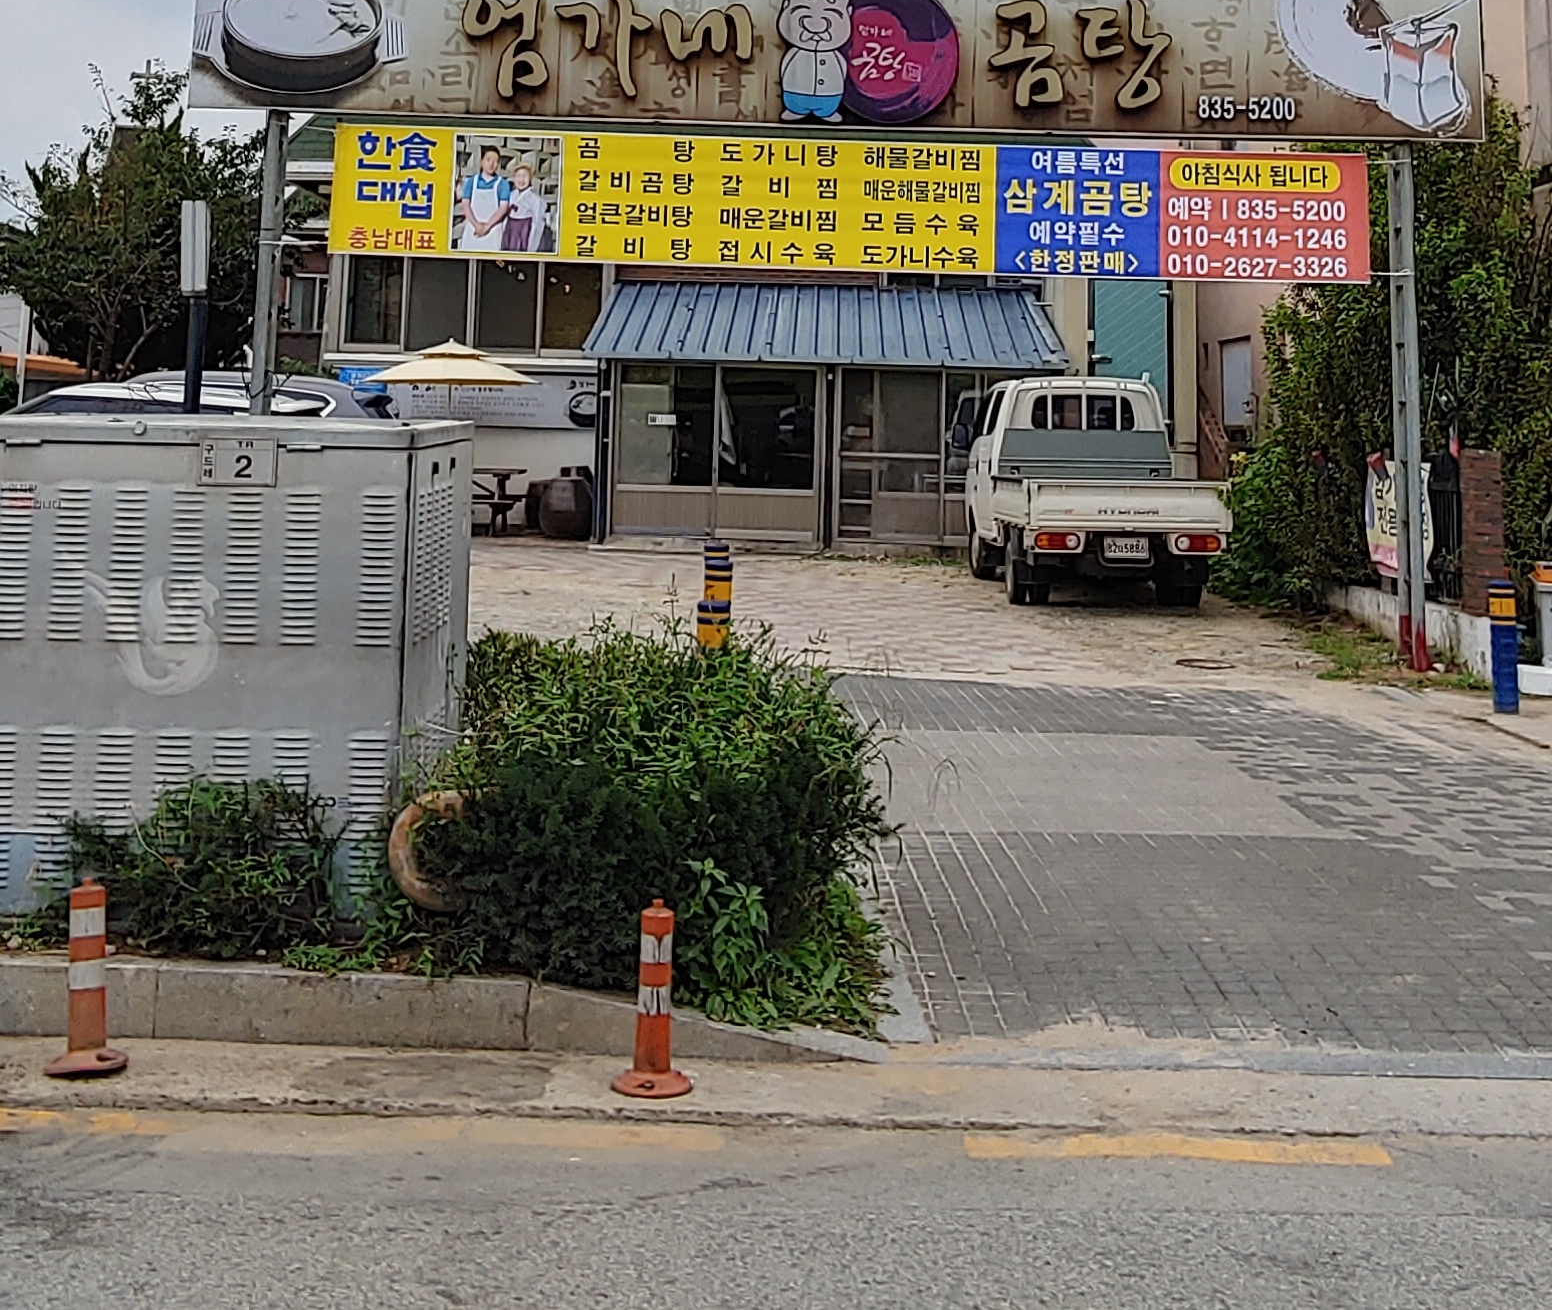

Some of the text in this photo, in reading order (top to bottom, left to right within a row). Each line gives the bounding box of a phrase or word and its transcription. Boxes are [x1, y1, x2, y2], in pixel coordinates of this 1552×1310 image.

[850, 42, 905, 81] 곰탕
[1197, 95, 1296, 121] 835-5200
[357, 130, 438, 172] 한食
[720, 141, 838, 167] 도가니탕
[863, 147, 981, 173] 해물갈비찜
[1032, 151, 1125, 176] 여름특선
[578, 170, 695, 195] 갈비곰탕
[721, 174, 837, 200] 갈비찜
[1180, 163, 1328, 189] 아침식사 됩니다
[356, 178, 434, 220] 대첩
[862, 178, 981, 204] 매운해물갈비찜
[1003, 178, 1151, 217] 삼계곰탕
[576, 202, 694, 227] 얼큰갈비탕
[719, 206, 837, 233] 매운갈비찜
[1167, 198, 1346, 222] 예약 835-5200
[861, 211, 979, 236] 모듬수육
[1028, 219, 1125, 245] 예약필수
[348, 227, 437, 251] 충남대표
[576, 235, 693, 261] 갈비탕
[1167, 226, 1347, 250] 010-4114-1246
[718, 238, 836, 265] 접시수육
[860, 244, 979, 270] 도가니수육
[1014, 250, 1140, 275] <한정판매>
[1167, 254, 1348, 278] 010-2627-3326
[203, 443, 214, 478] 구드레
[234, 454, 253, 479] 2
